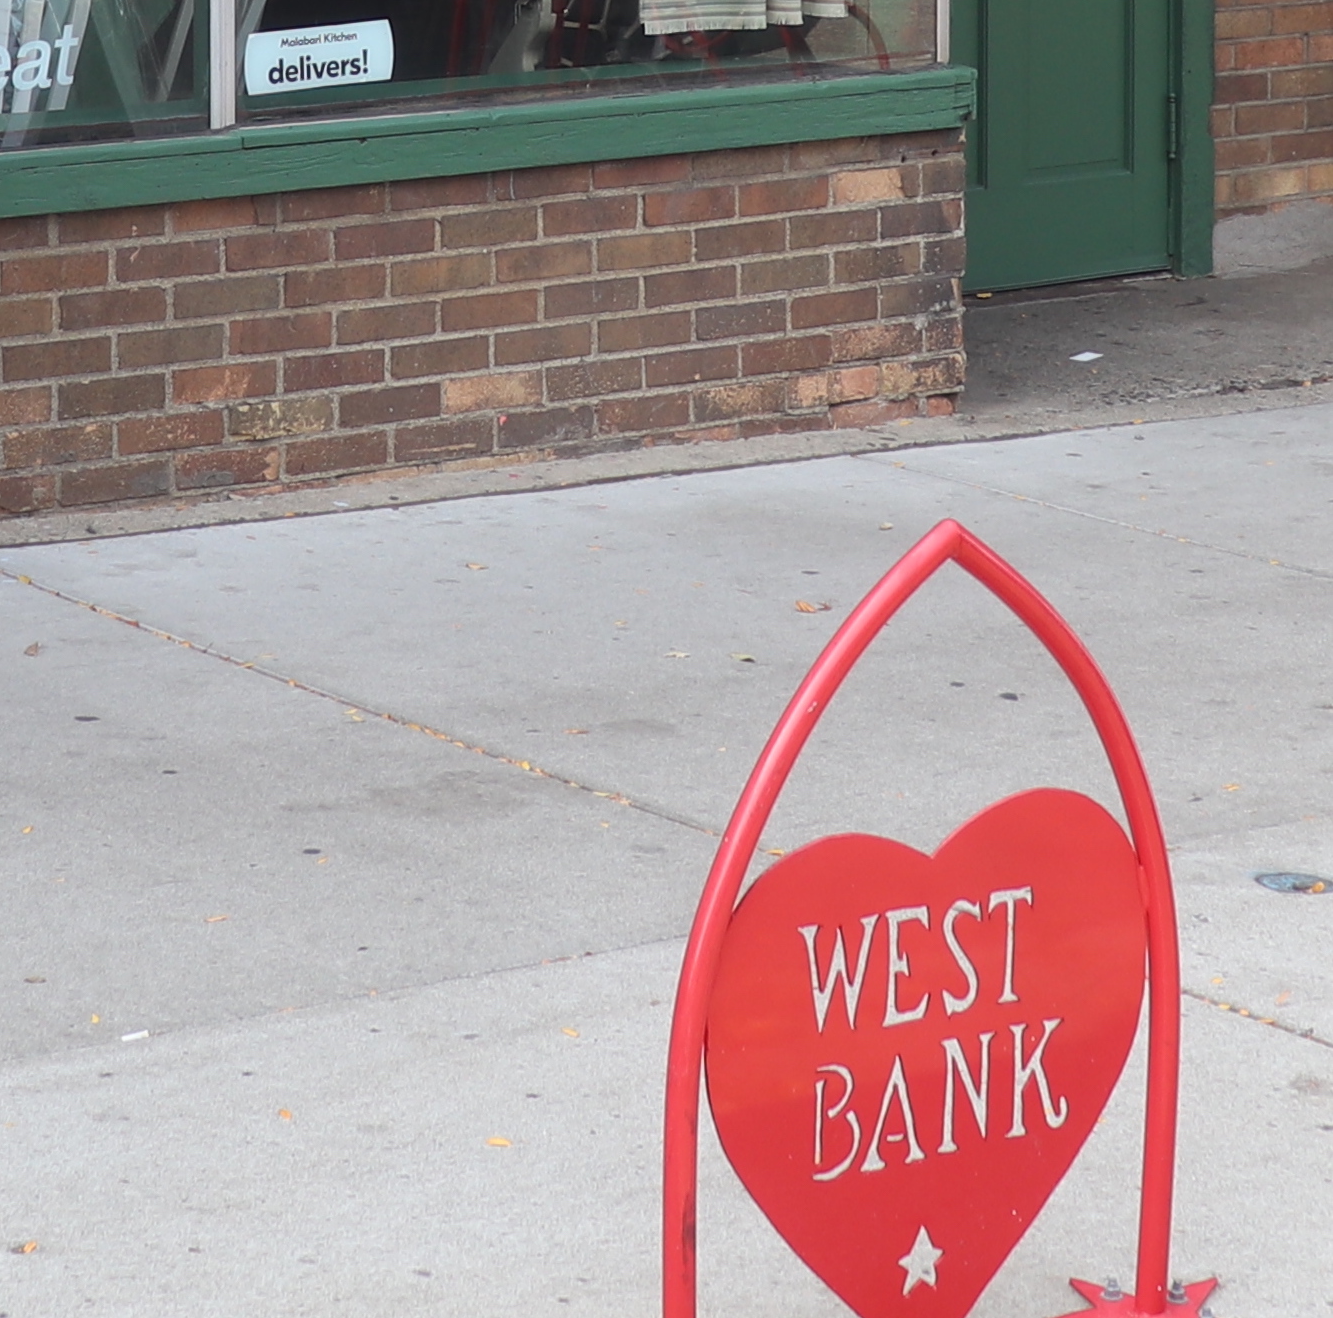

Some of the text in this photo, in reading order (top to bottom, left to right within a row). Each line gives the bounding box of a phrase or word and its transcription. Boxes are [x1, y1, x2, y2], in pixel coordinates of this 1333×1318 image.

[267, 48, 369, 85] delivers!
[323, 31, 358, 44] Kitchen
[797, 885, 1034, 1035] WEST
[812, 1017, 1069, 1182] BANK
